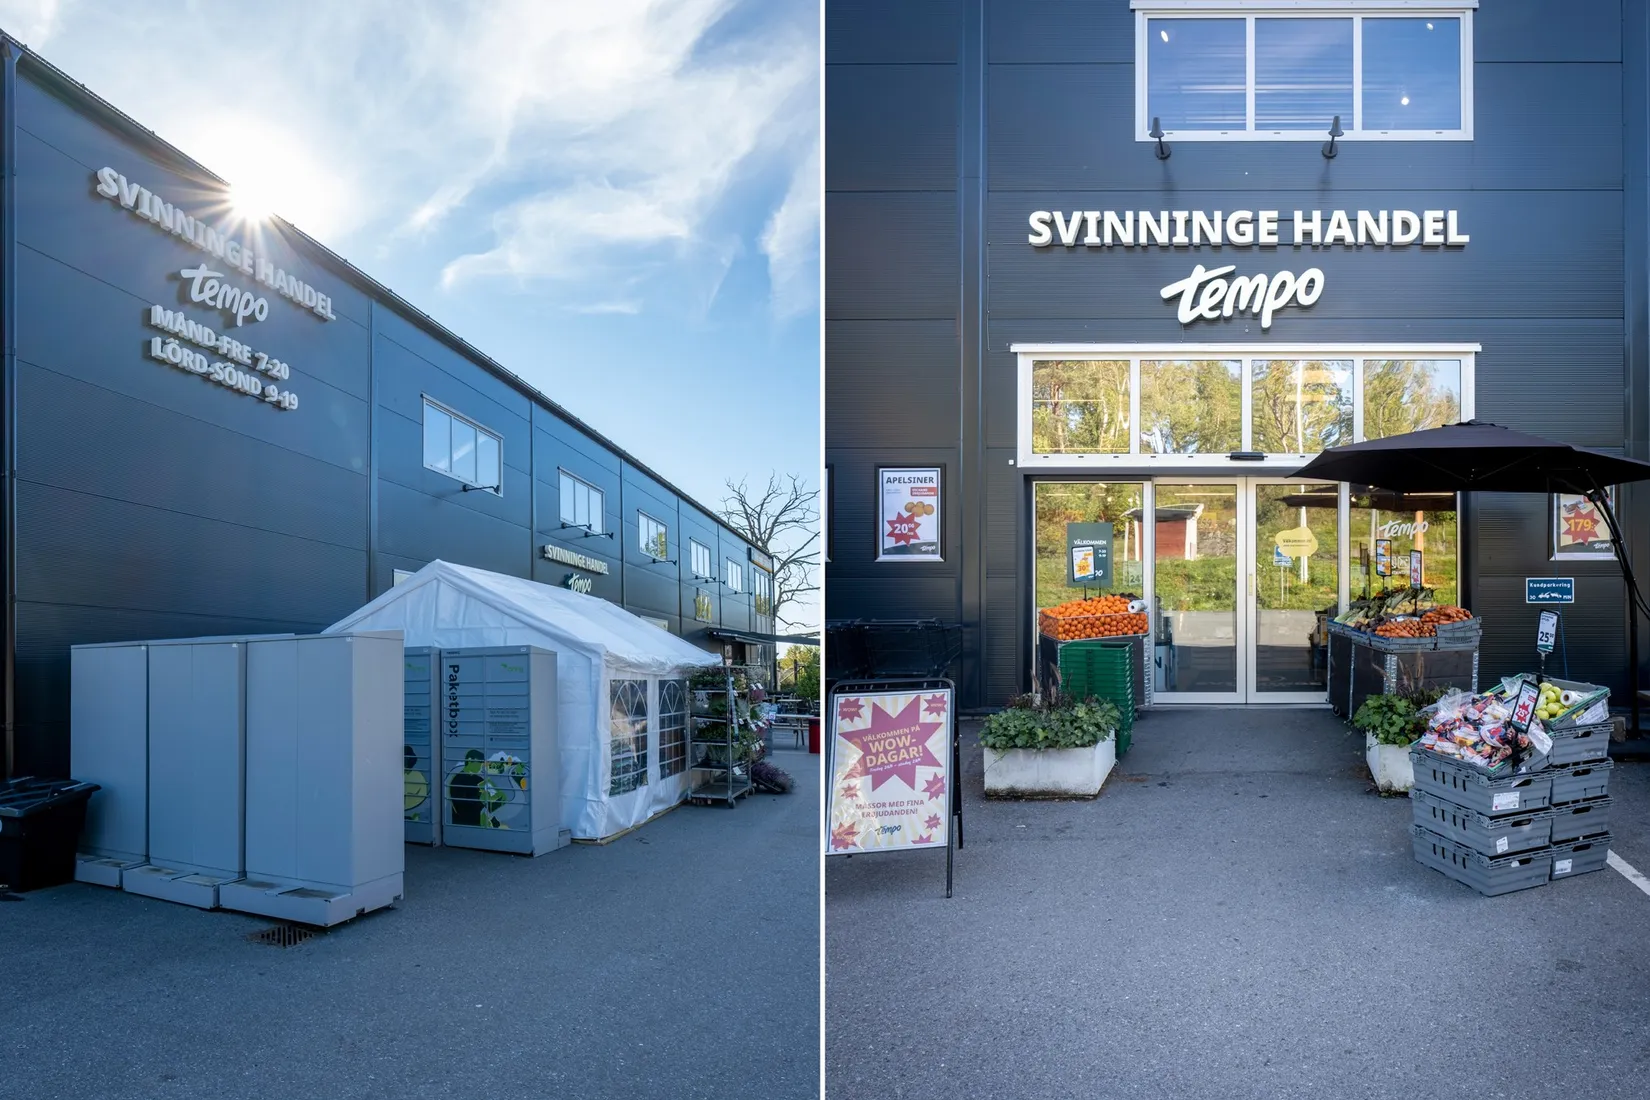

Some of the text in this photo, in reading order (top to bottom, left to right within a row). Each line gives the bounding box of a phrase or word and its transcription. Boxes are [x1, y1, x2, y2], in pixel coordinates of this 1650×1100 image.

[1028, 209, 1470, 248] SVINNINGE HANDEL
[96, 166, 337, 321] SVINNINGE HANDEL
[180, 263, 269, 327] tempo
[1160, 264, 1325, 330] tempo
[150, 304, 290, 381] MÅND-FRE 7-20
[150, 336, 299, 411] LÖRD-SÖND 9-19
[885, 476, 934, 484] APELSINER
[894, 523, 908, 534] 20
[1378, 520, 1429, 540] tempo
[1568, 519, 1591, 532] 179
[544, 544, 609, 575] SVINNINGE HANDEL
[1539, 631, 1550, 643] 25
[448, 664, 460, 738] Paketbox
[862, 724, 920, 742] VÄLKOMMEN PÅ
[869, 734, 917, 754] WOW-
[866, 745, 924, 768] DAGAR!
[888, 800, 905, 808] MED
[875, 824, 902, 836] tempo
